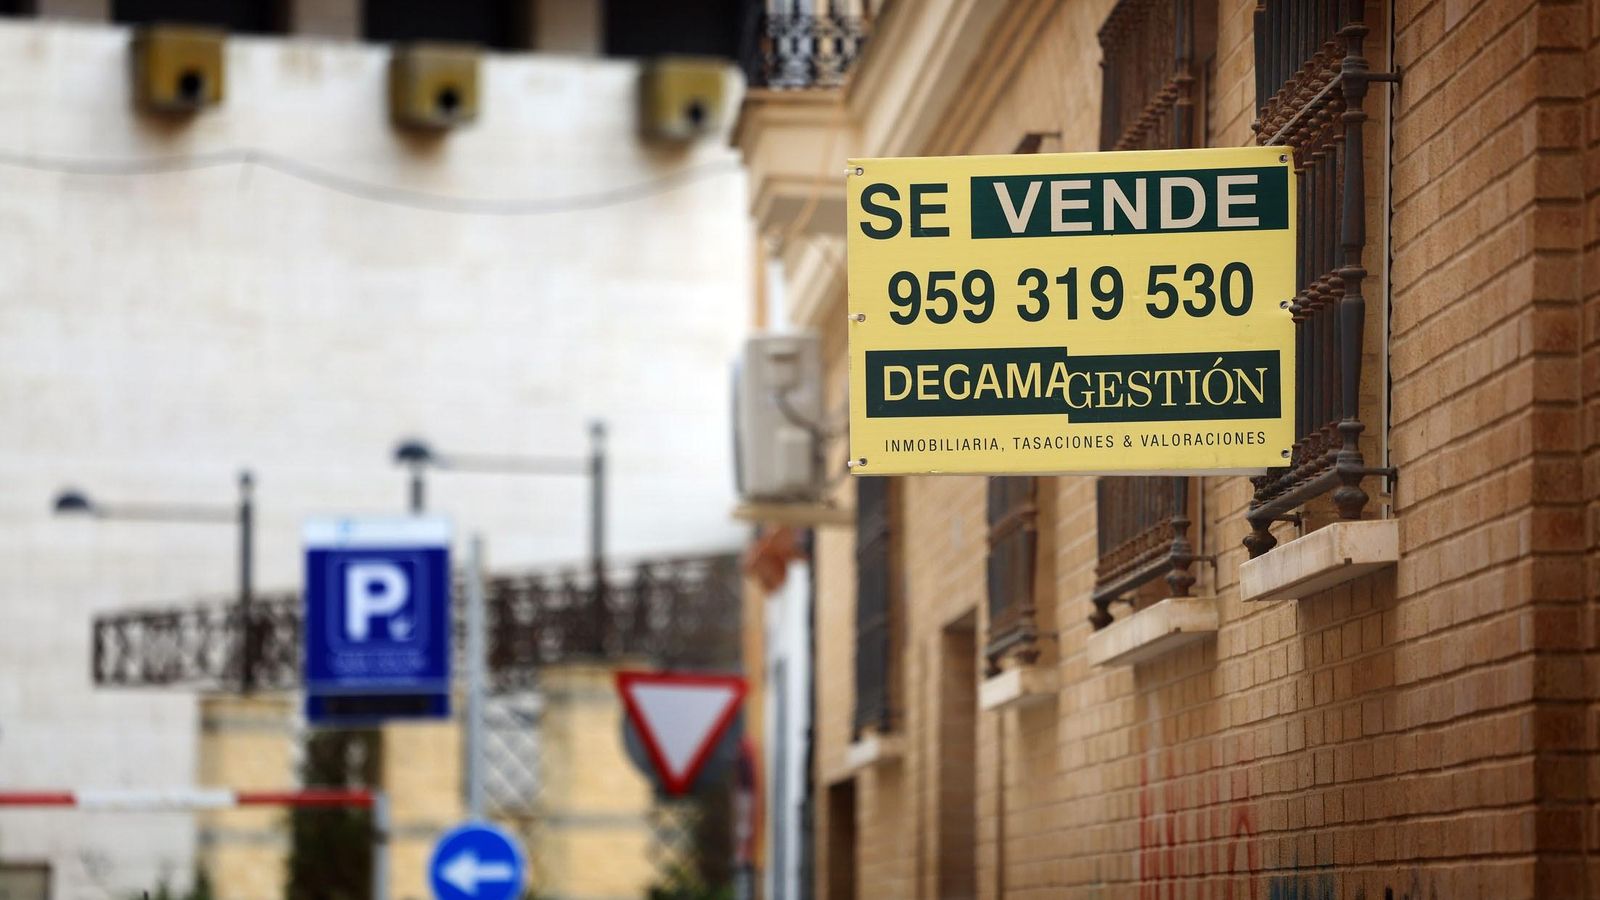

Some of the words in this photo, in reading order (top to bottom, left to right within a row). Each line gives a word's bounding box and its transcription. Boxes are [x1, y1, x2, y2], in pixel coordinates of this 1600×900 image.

[859, 183, 951, 240] SE
[992, 174, 1260, 234] VENDE
[887, 269, 996, 326] 959
[1016, 265, 1124, 321] 319
[1145, 261, 1254, 319] 530
[884, 437, 1006, 453] INMOBILIARIA,
[1012, 435, 1114, 451] TASACIONES
[1122, 434, 1133, 448] &
[1140, 431, 1267, 448] VALORACIONES
[346, 563, 409, 643] P
